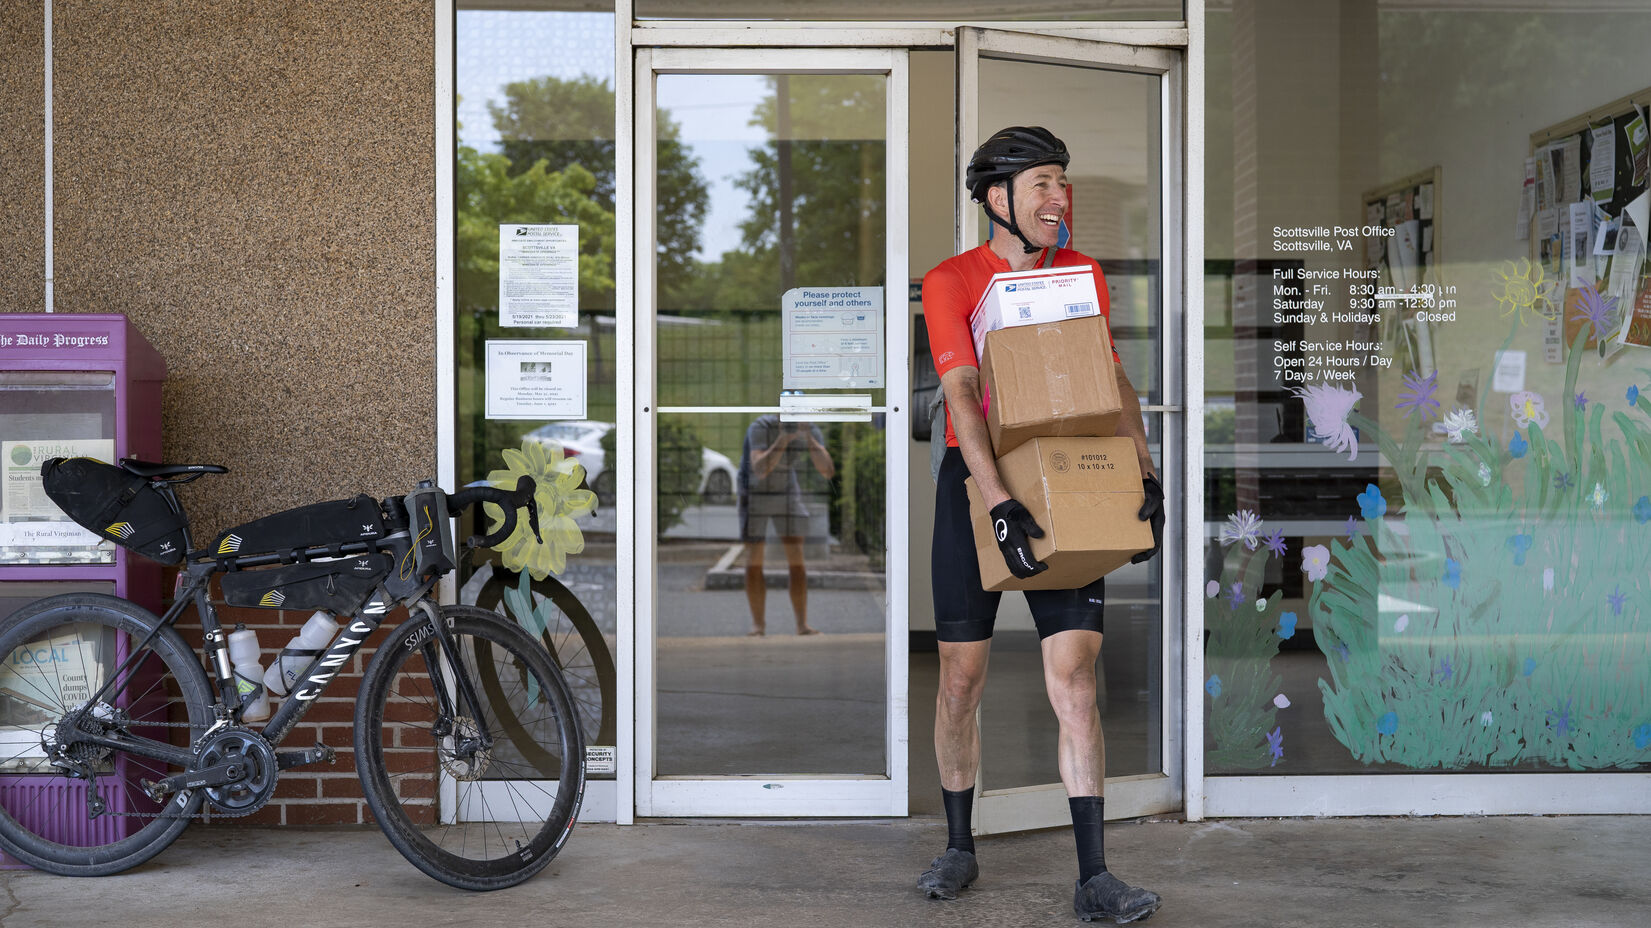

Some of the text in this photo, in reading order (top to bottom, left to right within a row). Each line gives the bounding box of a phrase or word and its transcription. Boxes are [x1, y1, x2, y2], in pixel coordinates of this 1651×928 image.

[1273, 226, 1396, 238] Scottsville Post Office
[1273, 240, 1353, 252] Scottsville, VA
[1273, 268, 1380, 280] Full Service Hours:
[832, 291, 861, 300] protect
[1273, 285, 1302, 296] Mon.
[1313, 285, 1331, 296] Fri.
[1350, 285, 1375, 295] 8:30
[1378, 287, 1396, 295] am
[1410, 284, 1435, 295] 4:30
[795, 300, 826, 308] yourself
[1273, 299, 1324, 311] Saturday
[1350, 299, 1375, 309] 9:30
[1378, 300, 1396, 308] am
[1438, 300, 1456, 310] pm
[1273, 312, 1456, 325] Sunday & Holidays Closed
[0, 333, 109, 348] he Daily Progress
[1274, 340, 1383, 351] Self Service Hours:
[1274, 356, 1393, 369] Open 24 Hours / Day
[1274, 370, 1355, 382] 7 Days / Week
[38, 446, 76, 454] RURAL
[1017, 547, 1034, 570] ERGON
[13, 648, 68, 665] LOCAL
[295, 601, 386, 701] CANYON
[62, 674, 87, 683] County
[63, 684, 88, 693] dumps
